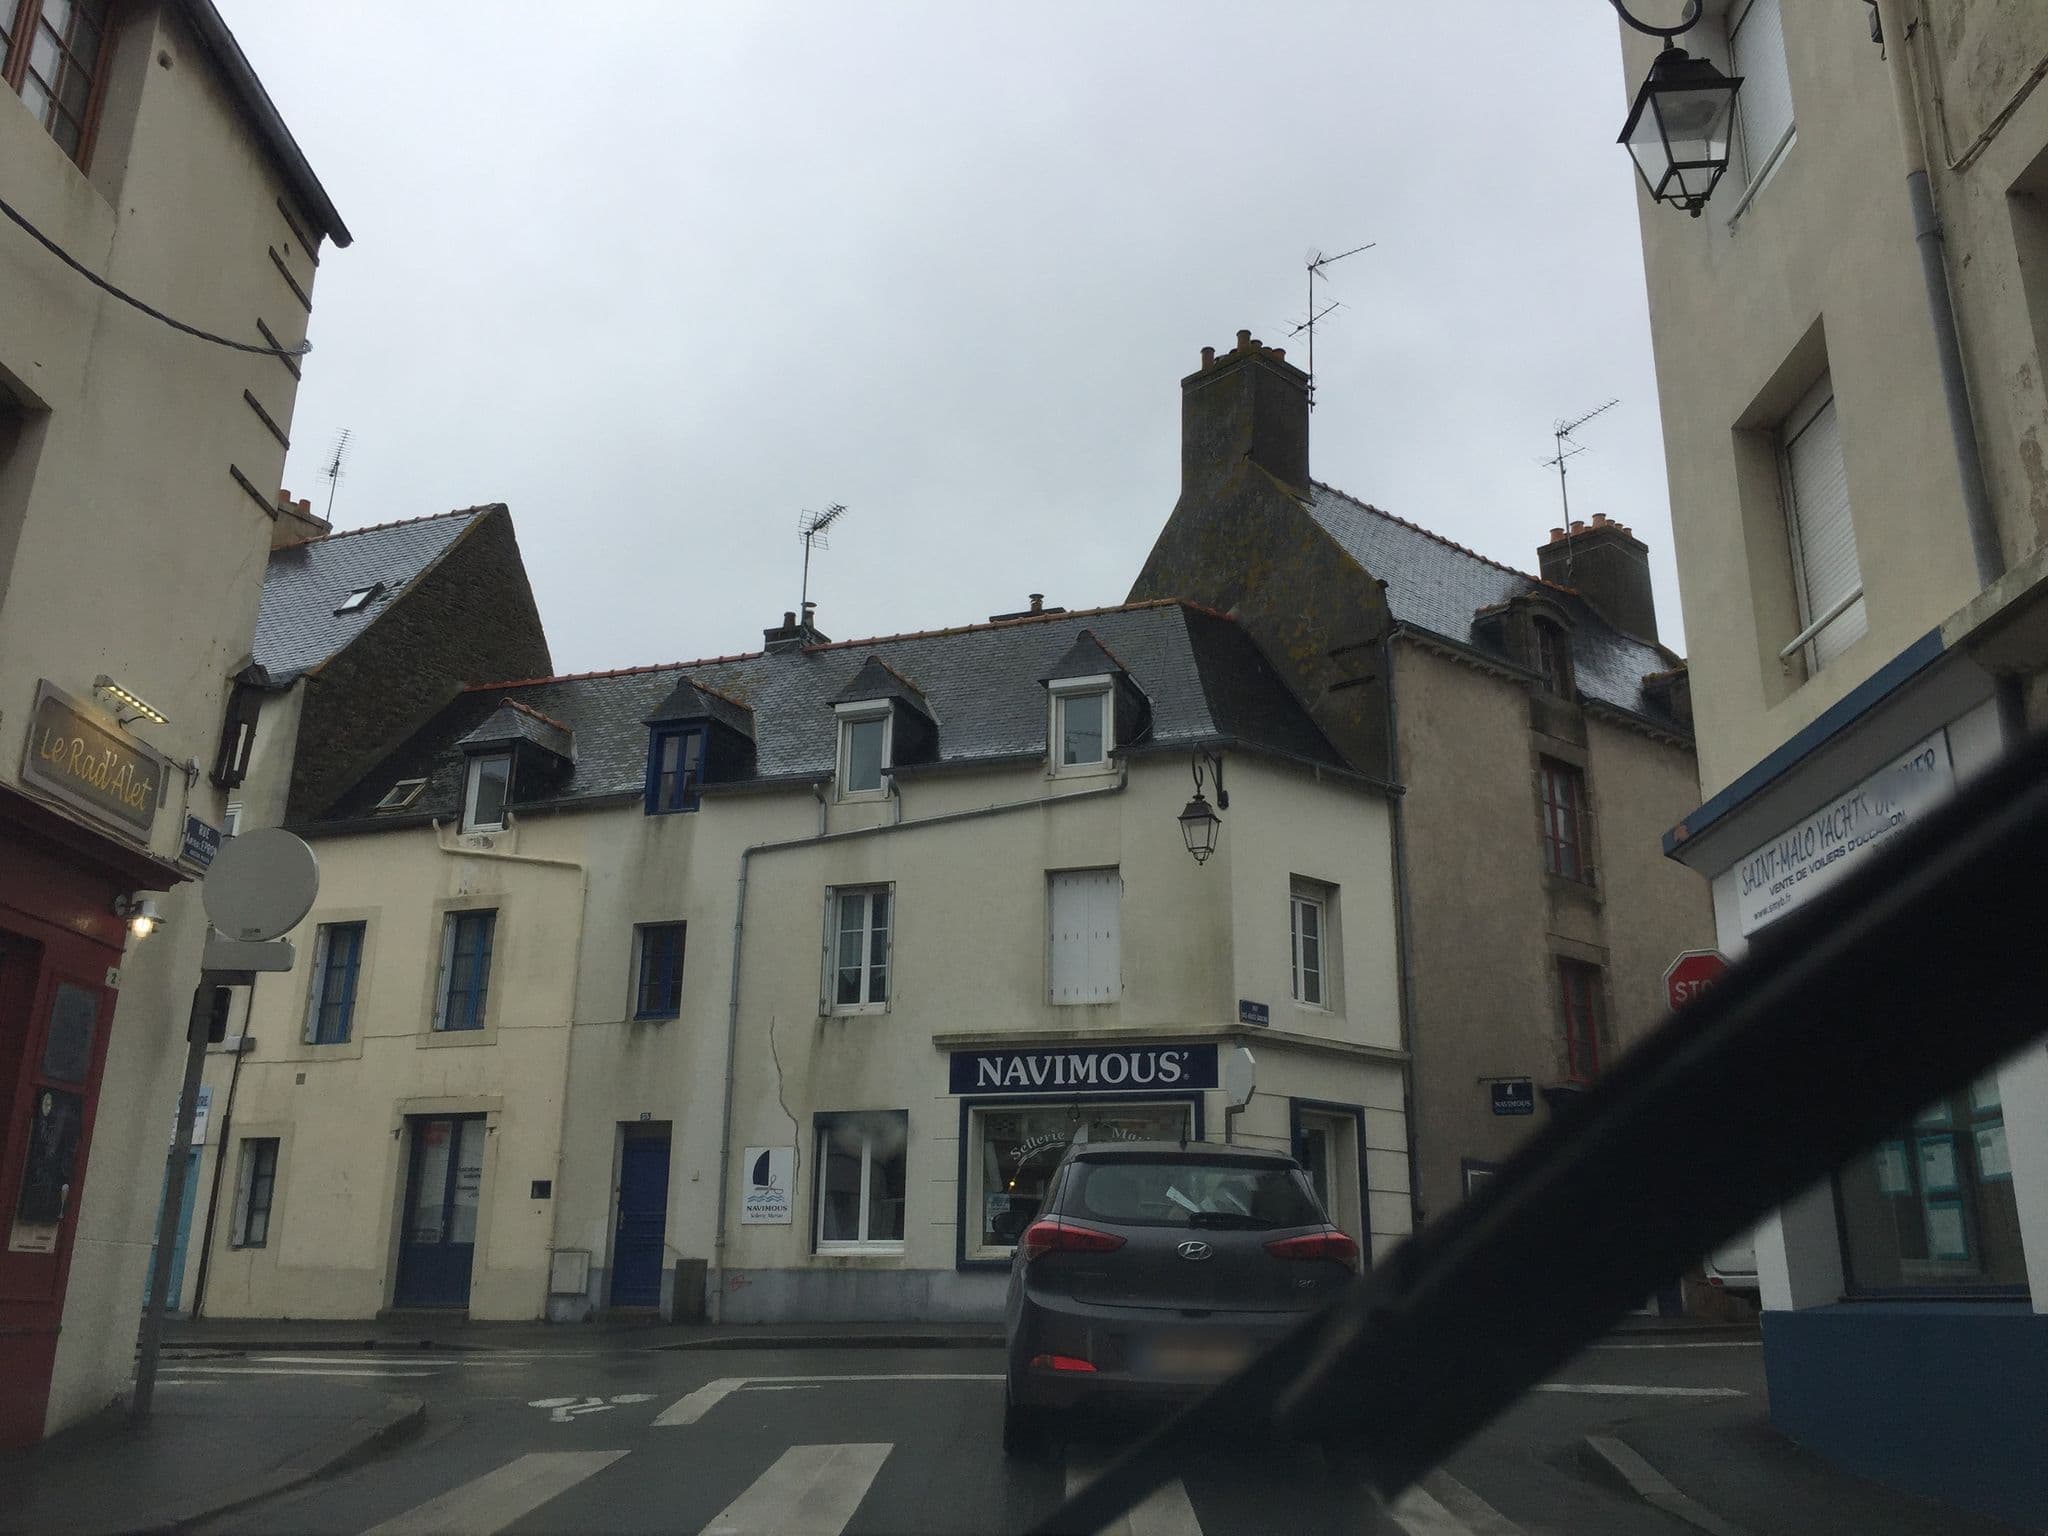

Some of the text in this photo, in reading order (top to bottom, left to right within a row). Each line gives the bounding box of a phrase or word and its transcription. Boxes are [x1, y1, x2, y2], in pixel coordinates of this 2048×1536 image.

[41, 728, 152, 810] Le Rad'Alet
[1742, 826, 1815, 896] SAINT-MALO
[1768, 874, 1795, 896] VENTE
[1796, 869, 1808, 882] DE
[1809, 845, 1846, 874] VOILIERS
[1009, 1130, 1065, 1160] Sellerie
[746, 1204, 788, 1212] NAVIMOUS
